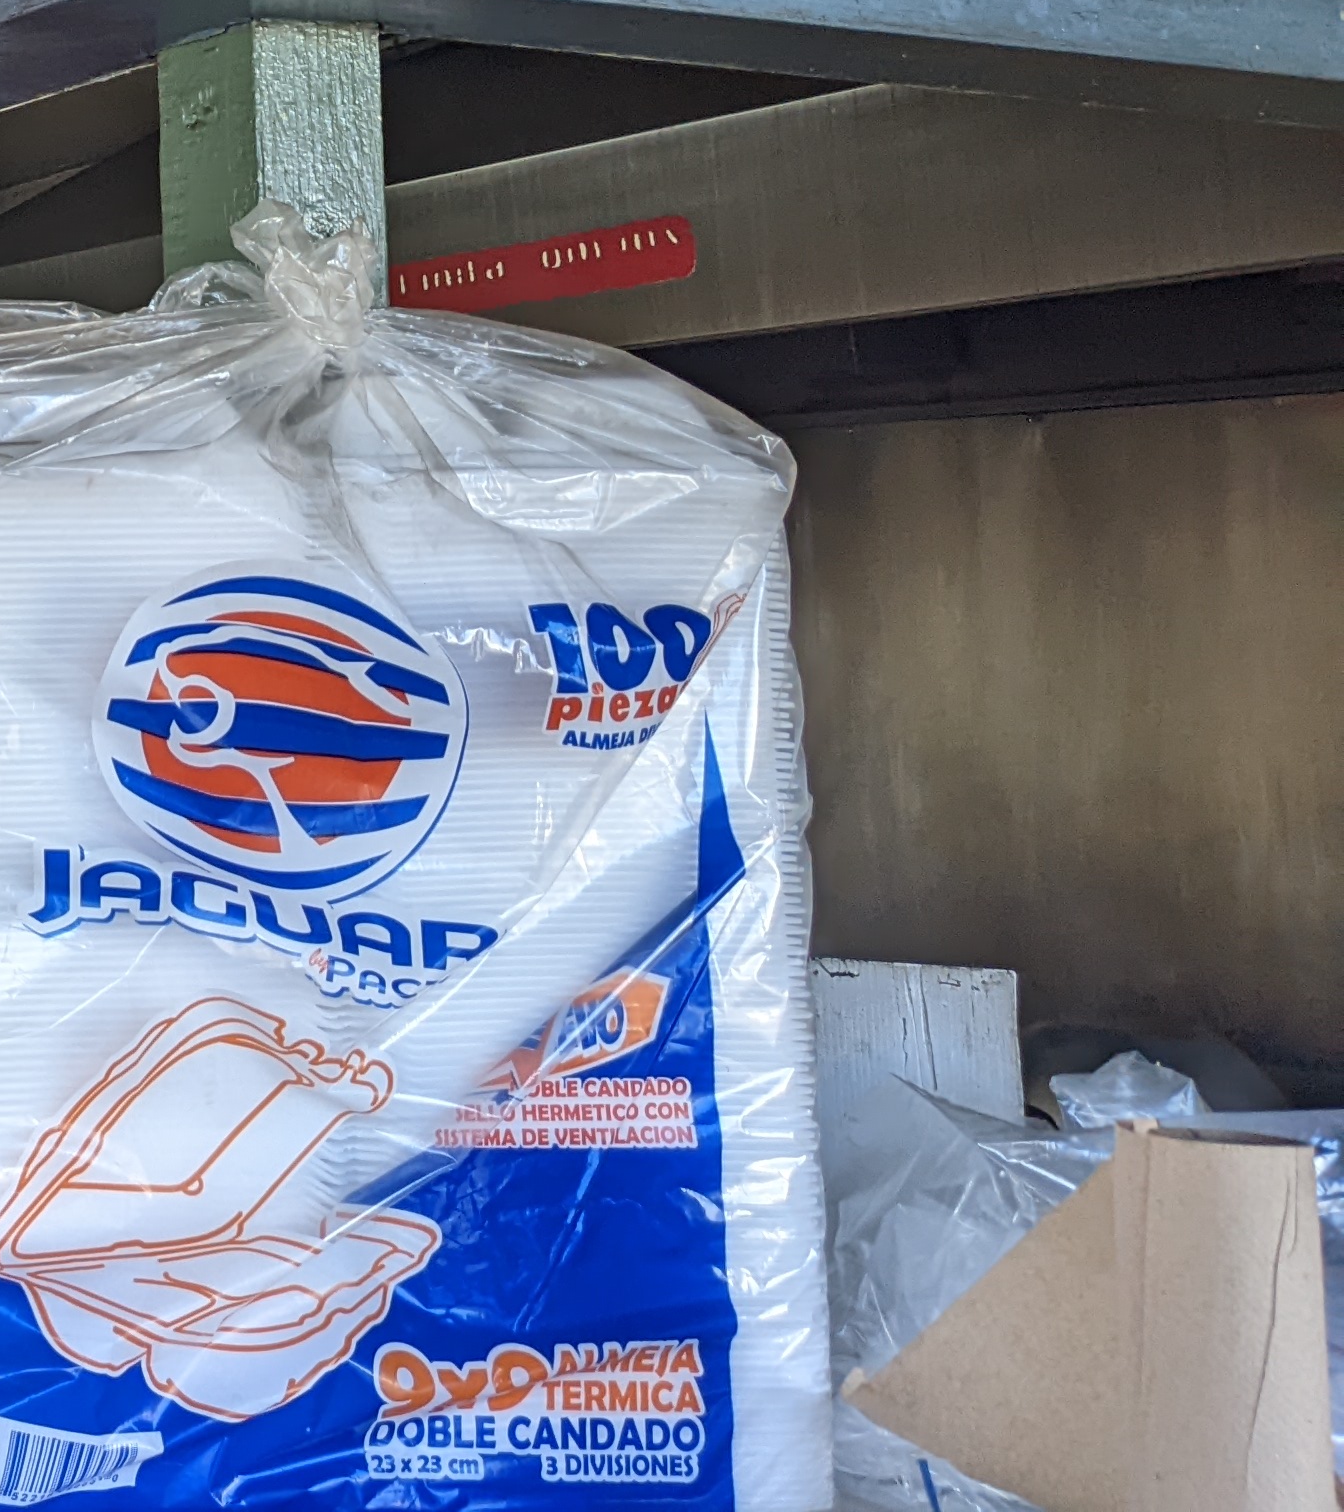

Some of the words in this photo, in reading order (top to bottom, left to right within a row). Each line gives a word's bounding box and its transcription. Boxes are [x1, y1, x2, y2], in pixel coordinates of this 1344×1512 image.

[528, 602, 712, 694] 100
[545, 681, 679, 731] pieza
[562, 729, 635, 751] ALMEJA
[27, 845, 500, 971] JAGUAR
[325, 953, 448, 1000] PAC
[512, 1077, 579, 1098] OBLE
[584, 1077, 688, 1098] CANDADO
[455, 1102, 516, 1122] SELLO
[522, 1102, 639, 1122] HERMETICO
[644, 1101, 690, 1120] CON
[435, 1127, 517, 1147] SISTEMA
[522, 1127, 549, 1147] DE
[554, 1125, 694, 1147] VENTILACION
[378, 1349, 550, 1419] 9x9
[555, 1343, 700, 1379] ALMEJA
[542, 1379, 702, 1413] TERMICA
[368, 1414, 497, 1450] DOBLE
[507, 1414, 701, 1453] CANDADO
[370, 1454, 397, 1475] 23
[400, 1458, 413, 1474] x
[416, 1454, 443, 1475] 23
[447, 1455, 480, 1475] cm
[545, 1455, 559, 1476] 3
[565, 1454, 694, 1478] DIVISIONES
